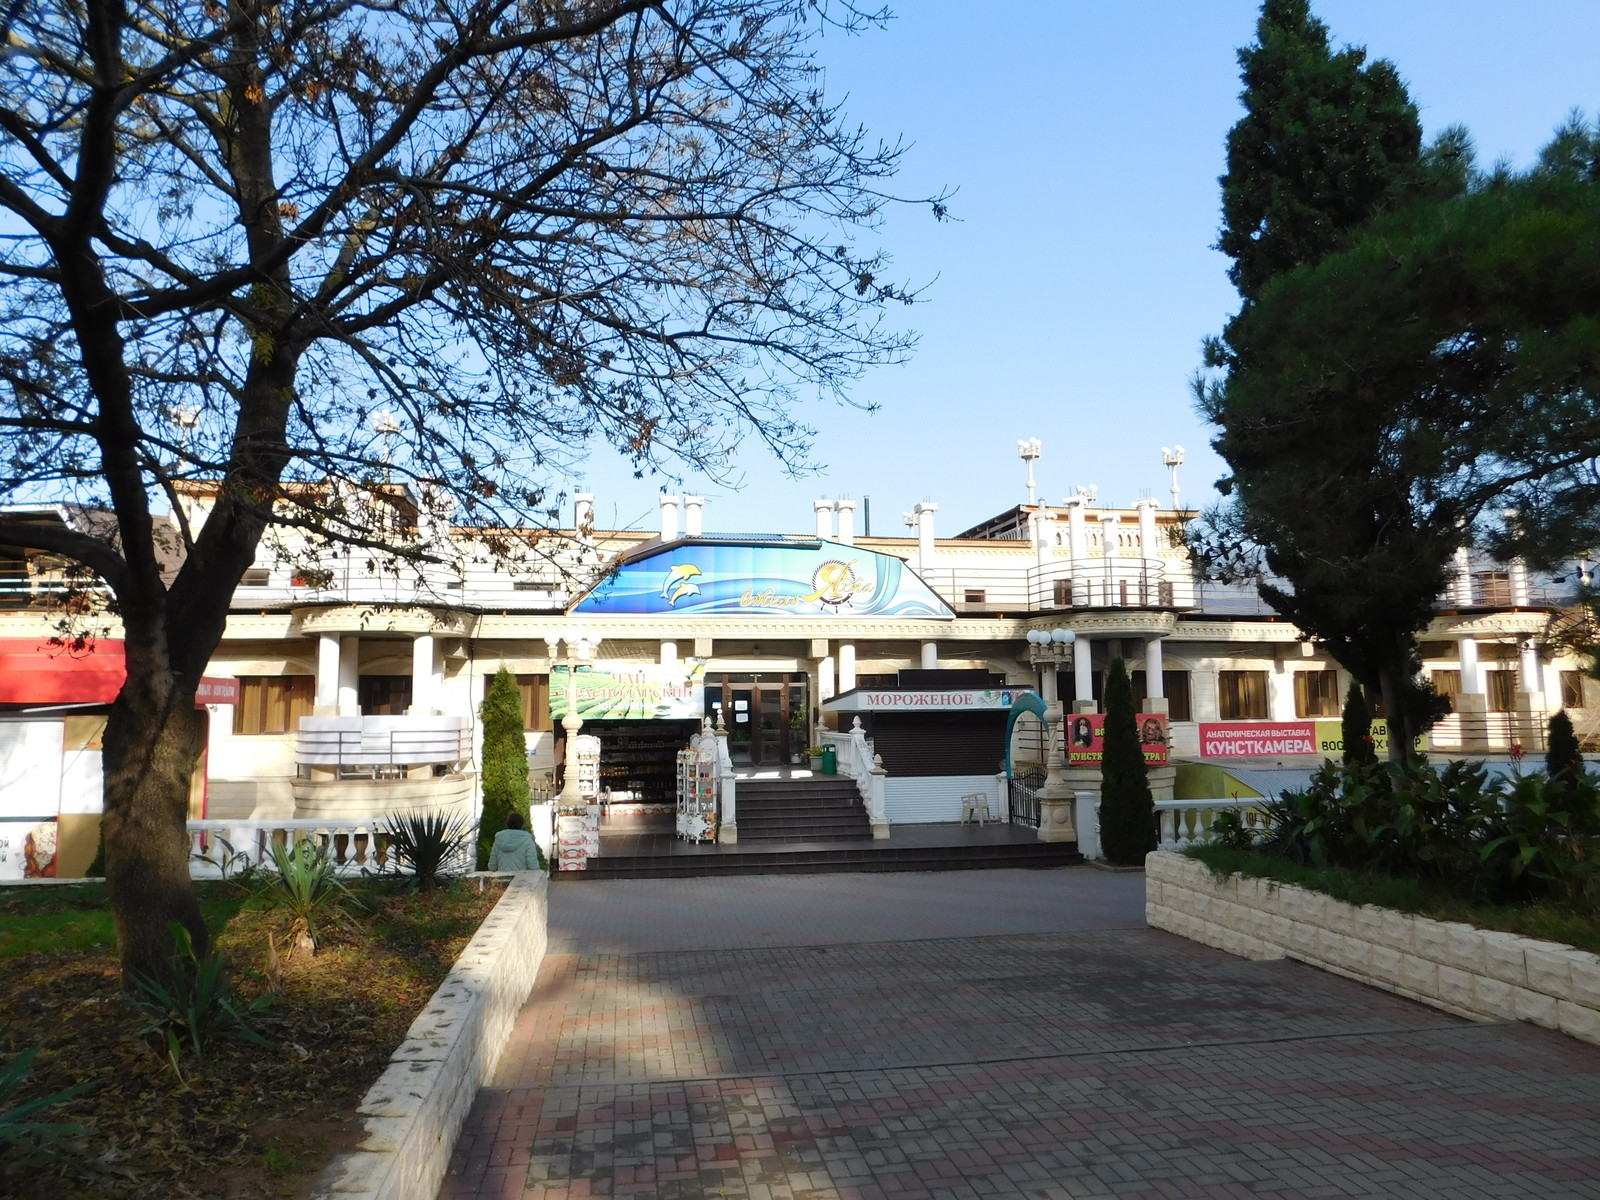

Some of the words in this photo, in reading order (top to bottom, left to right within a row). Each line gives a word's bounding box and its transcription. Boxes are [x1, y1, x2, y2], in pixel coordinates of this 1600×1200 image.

[866, 694, 974, 706] МОРОЖЕНОЕ
[1206, 730, 1271, 739] АНАТОМИЧЕСКАЯ
[1271, 729, 1311, 738] ВЫСТАВКА
[1205, 739, 1314, 755] КУНСТКАМЕРА
[1070, 752, 1103, 761] КУНСТК
